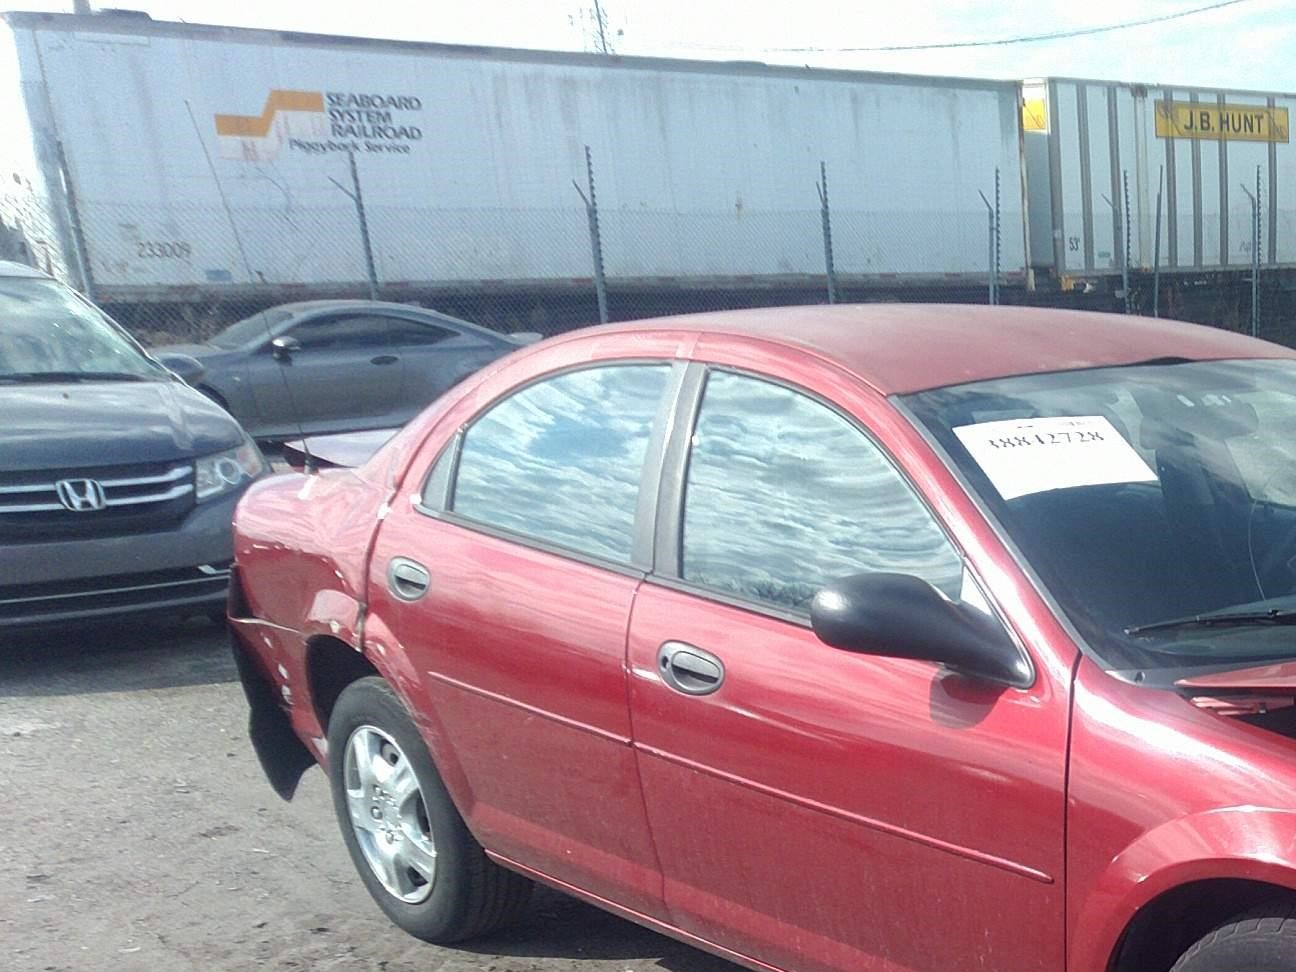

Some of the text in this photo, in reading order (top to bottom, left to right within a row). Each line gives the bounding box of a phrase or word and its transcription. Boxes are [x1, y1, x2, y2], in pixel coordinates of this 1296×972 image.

[326, 93, 422, 111] SEABOARD
[328, 109, 392, 125] SYSTEM
[1184, 110, 1264, 134] J.B. HUNT
[331, 124, 422, 140] RAILROAD
[363, 140, 411, 154] Service
